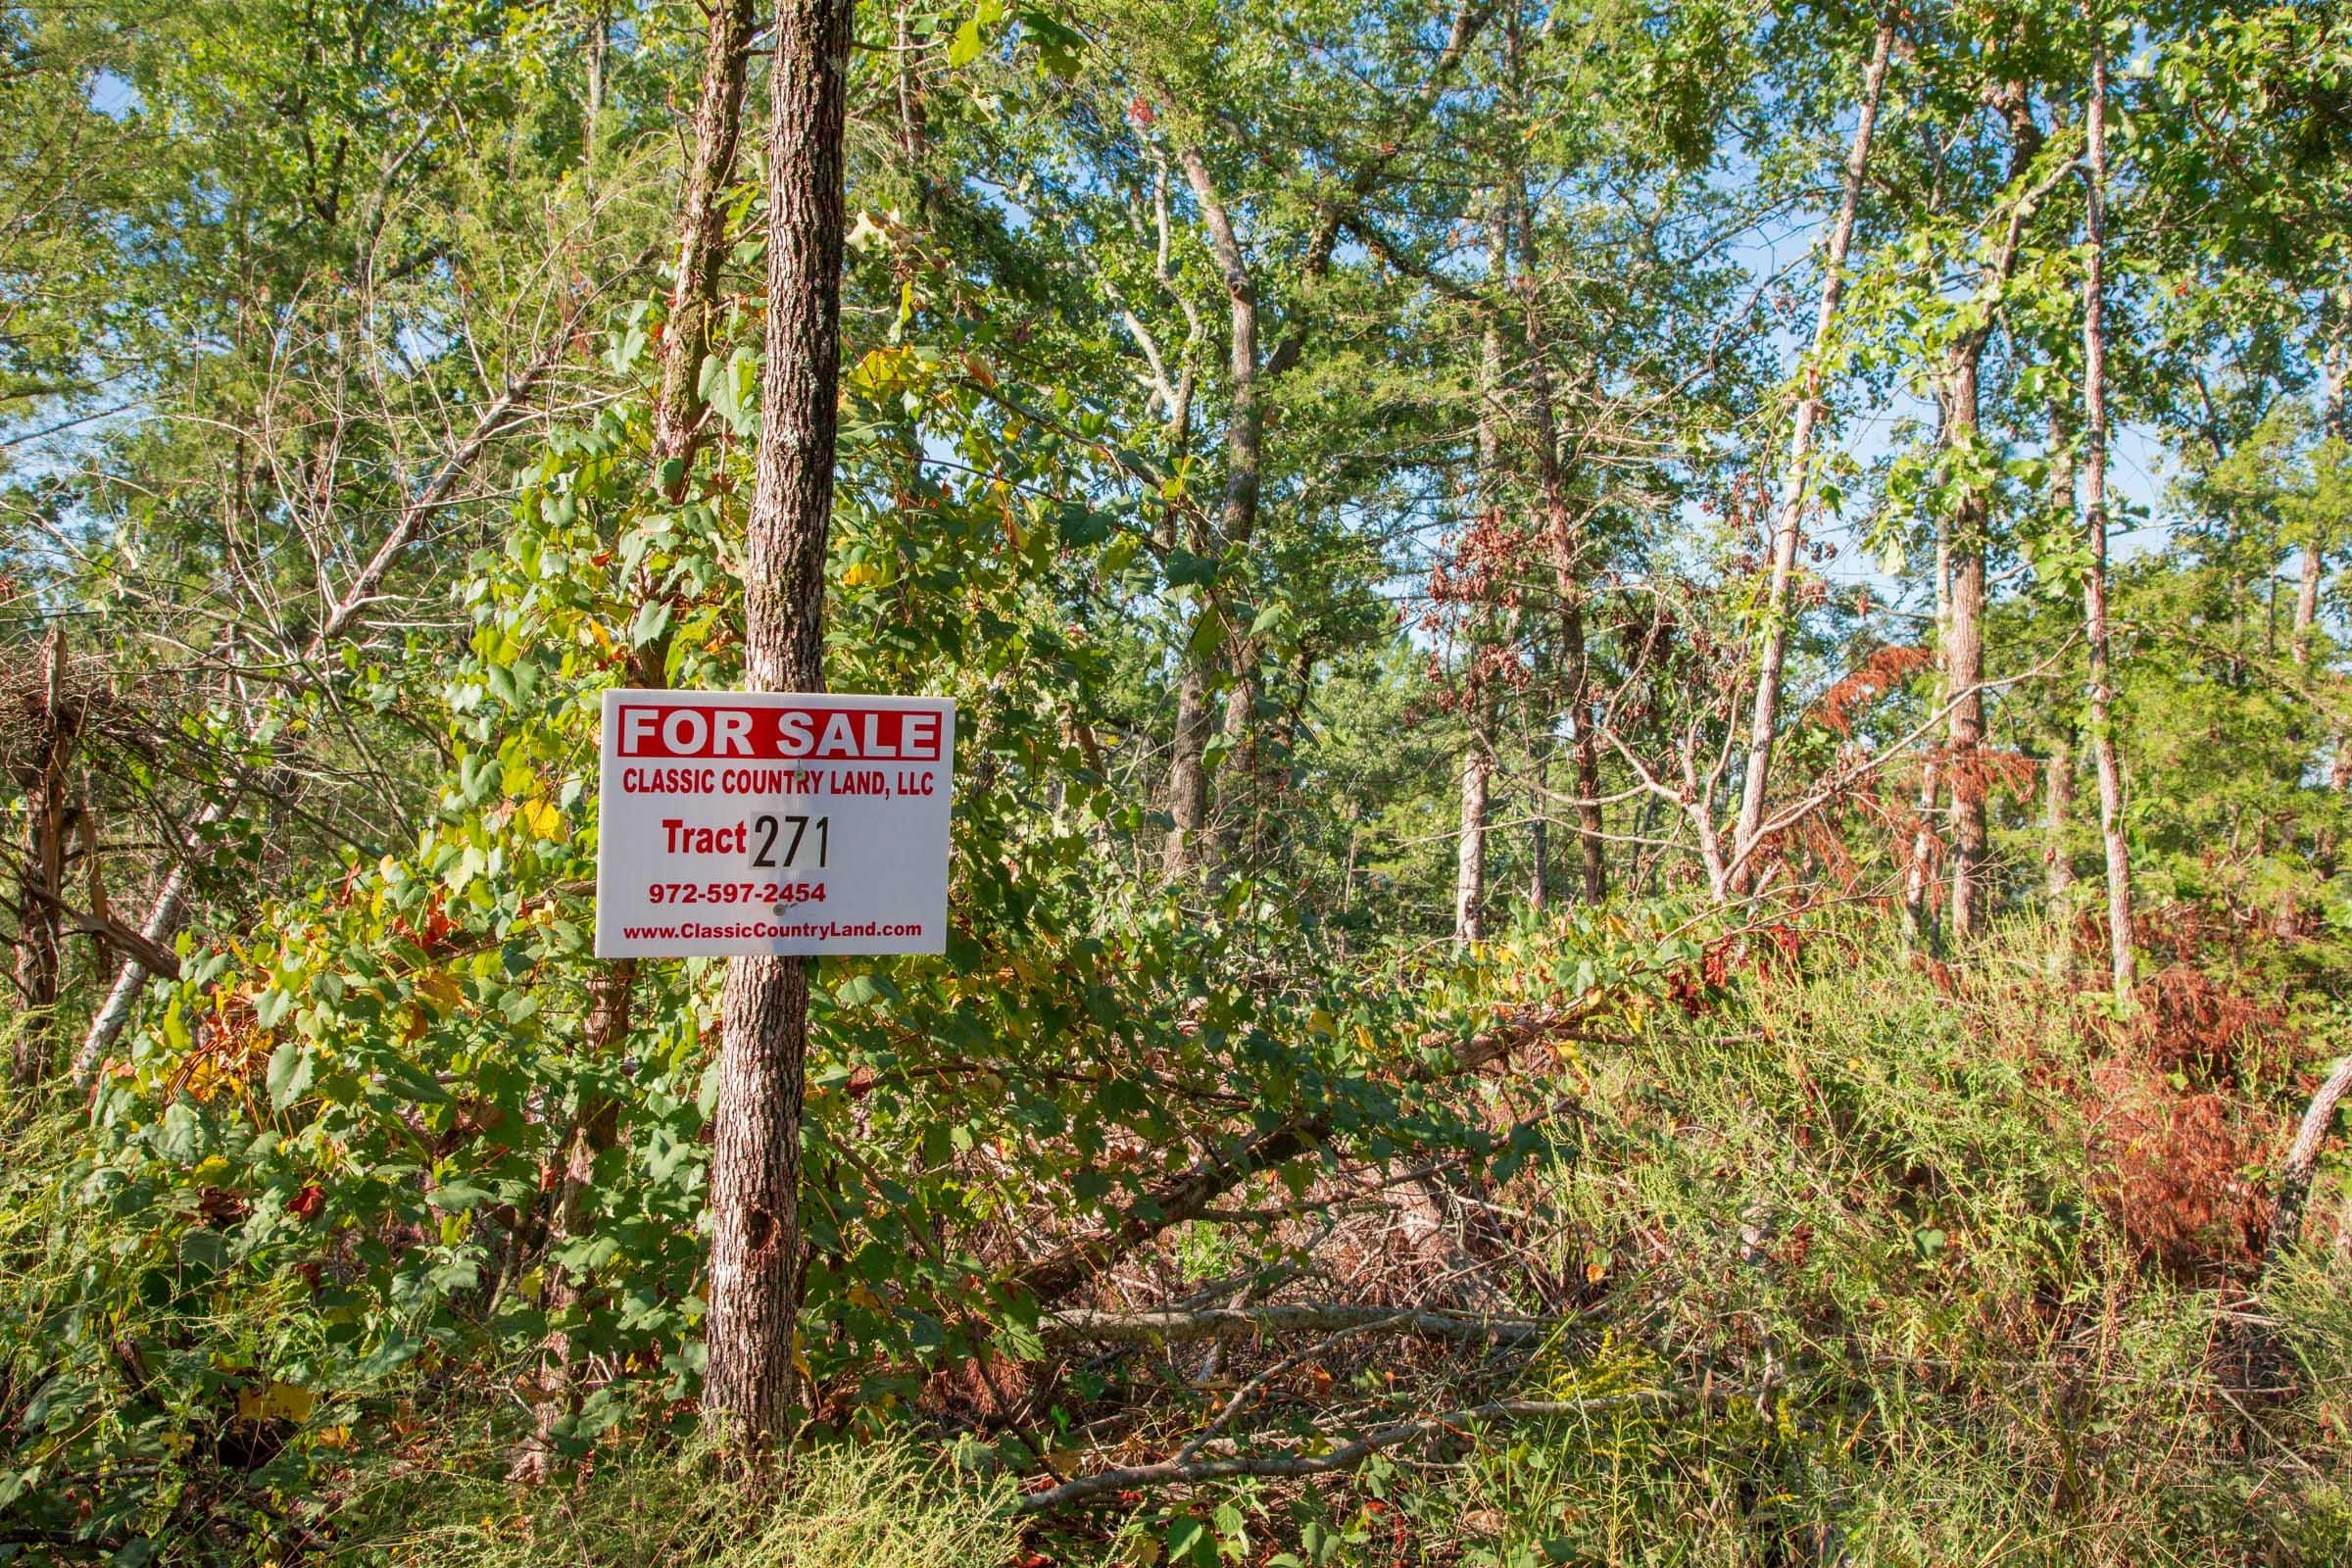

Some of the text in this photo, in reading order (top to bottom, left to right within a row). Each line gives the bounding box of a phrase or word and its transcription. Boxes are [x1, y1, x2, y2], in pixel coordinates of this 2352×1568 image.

[623, 709, 936, 758] FOR SALE
[623, 768, 934, 800] CLASSIC COUNTRY LAND, LLC
[662, 814, 830, 867] Tract 271
[649, 883, 826, 904] 972-597-2454
[623, 921, 922, 941] www.ClassicCountryLand.com
